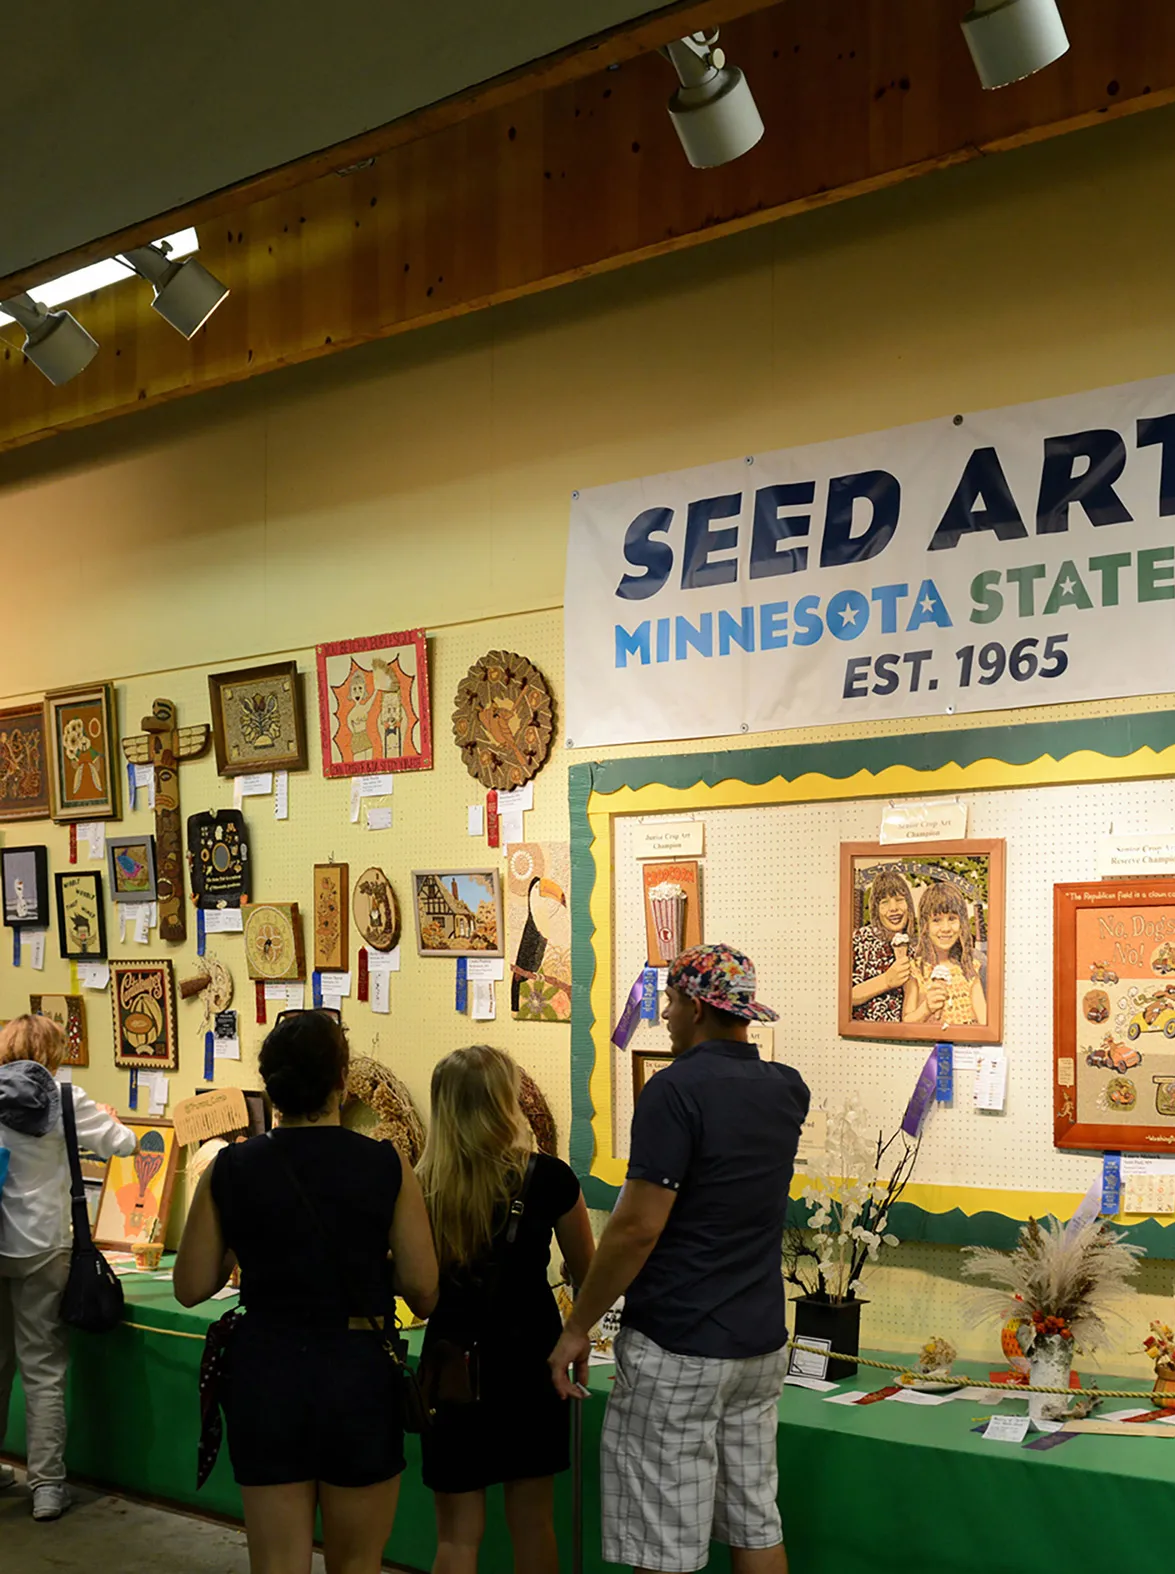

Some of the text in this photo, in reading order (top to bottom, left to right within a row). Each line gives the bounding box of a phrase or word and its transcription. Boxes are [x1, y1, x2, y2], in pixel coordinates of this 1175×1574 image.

[615, 471, 901, 601] SEED
[614, 578, 953, 669] MINNESOTA
[969, 551, 1175, 625] STATE
[842, 633, 1070, 700] EST. 1965
[867, 864, 971, 892] STATE FAIR
[1084, 892, 1116, 903] Republican
[1117, 891, 1133, 901] field
[1148, 890, 1166, 899] clown
[1113, 941, 1146, 967] No!
